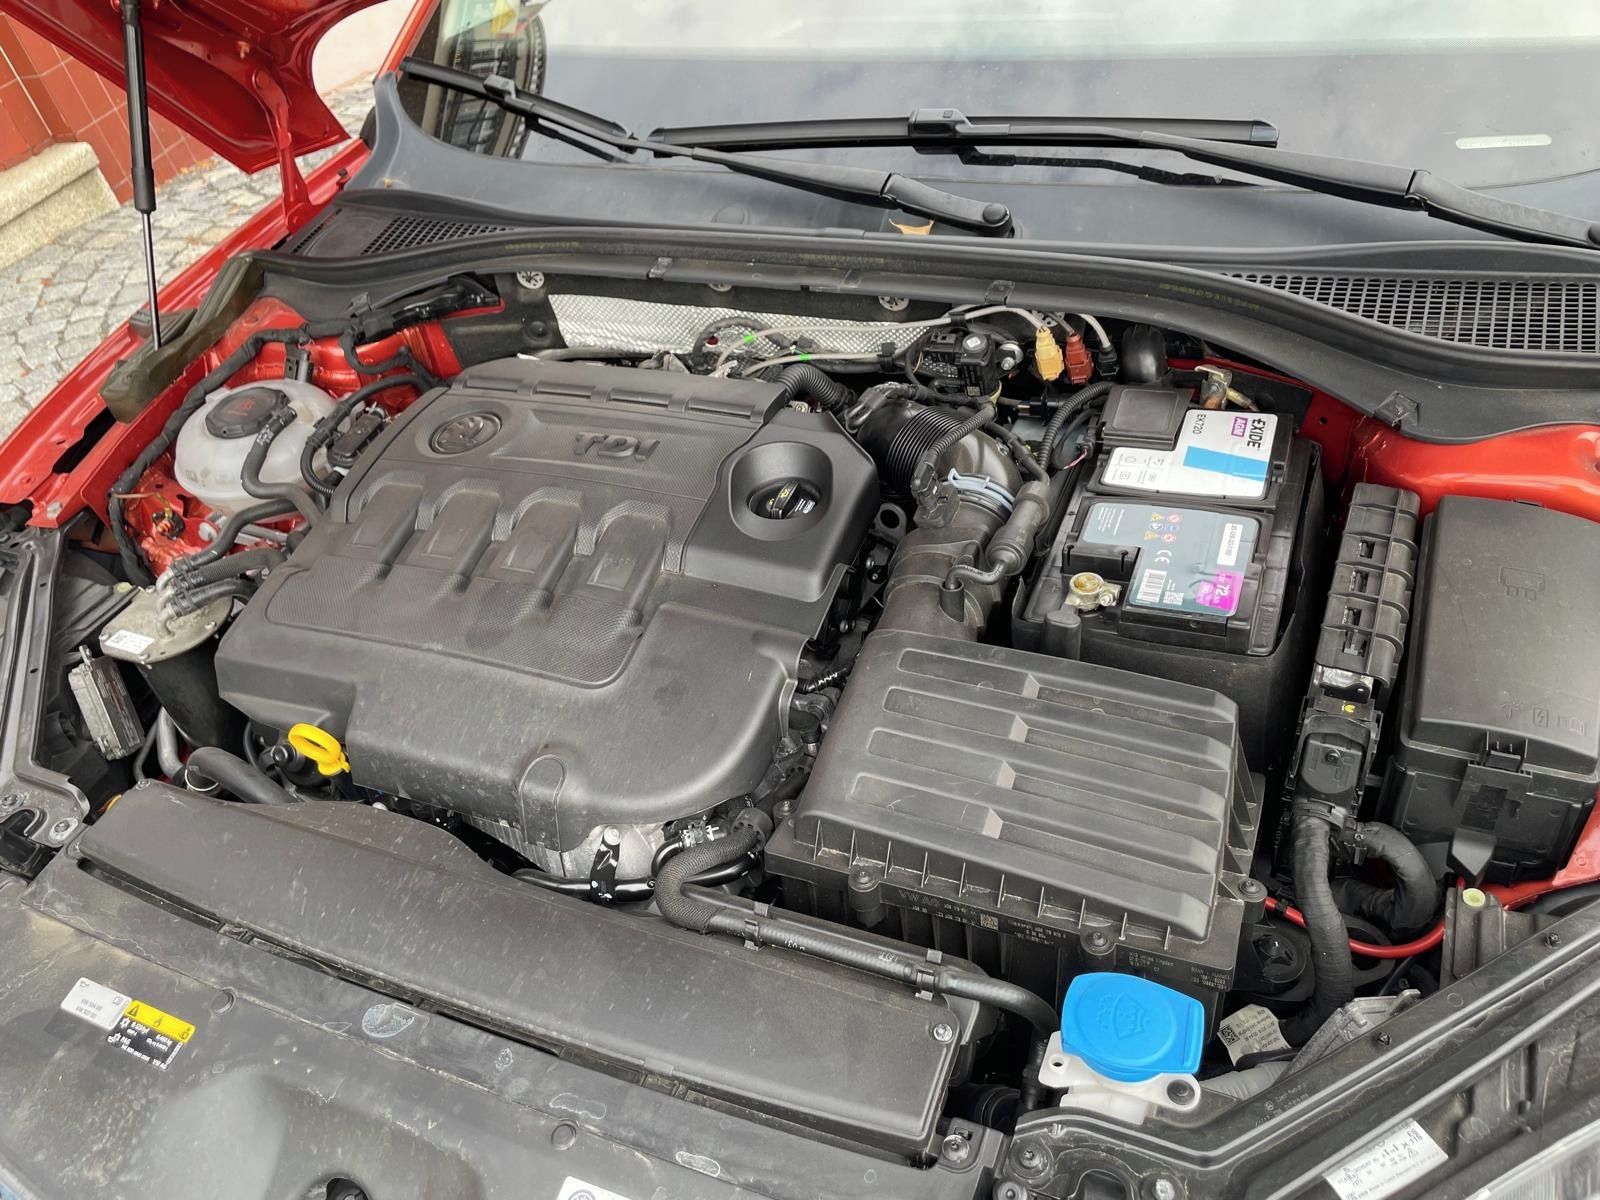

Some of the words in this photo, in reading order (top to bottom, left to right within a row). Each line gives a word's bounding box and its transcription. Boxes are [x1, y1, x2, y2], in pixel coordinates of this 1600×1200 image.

[1192, 413, 1207, 435] EK720
[1232, 416, 1247, 437] AGM
[1246, 417, 1266, 449] EXIDE
[574, 431, 661, 462] TDI
[1215, 583, 1230, 596] 72
